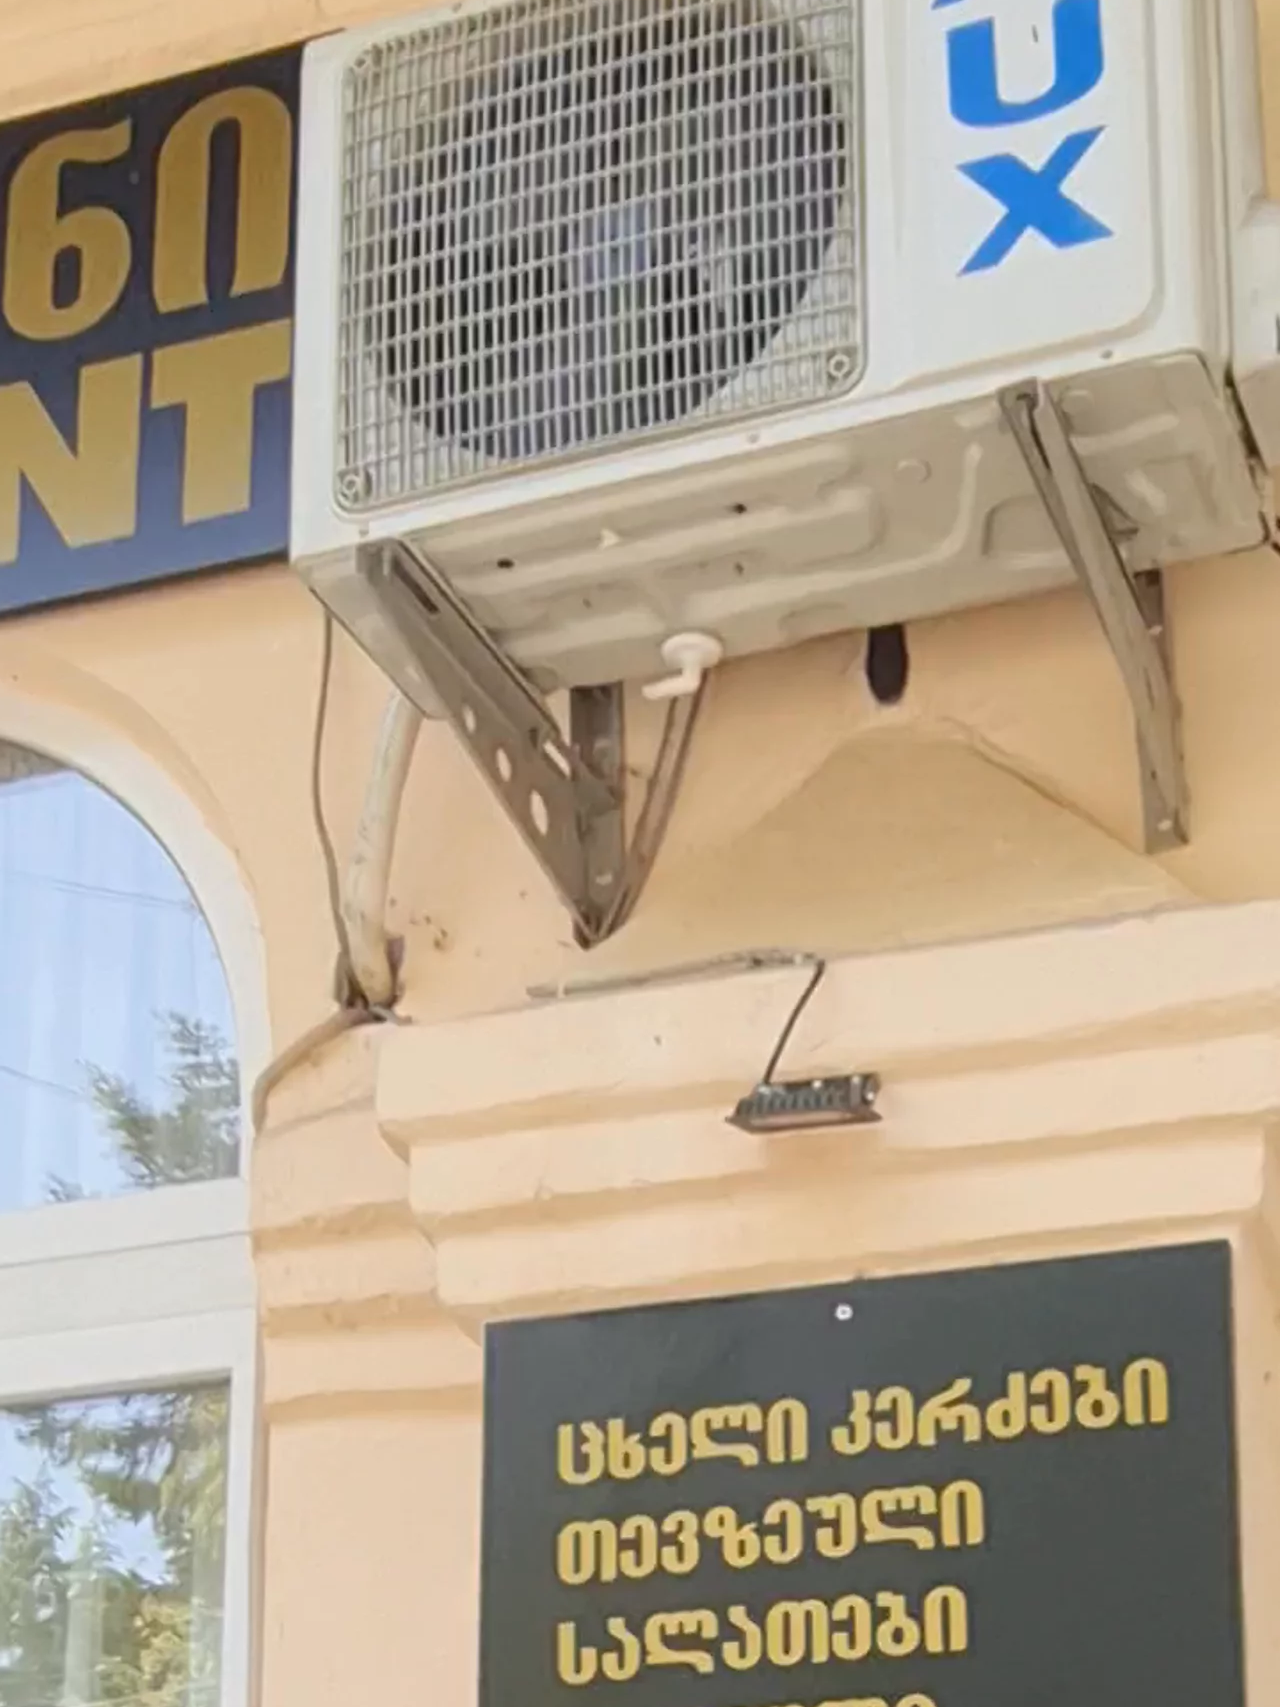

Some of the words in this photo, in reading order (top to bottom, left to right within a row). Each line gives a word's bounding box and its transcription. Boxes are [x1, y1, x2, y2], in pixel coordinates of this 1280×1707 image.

[556, 1397, 808, 1486] ცხელი
[830, 1357, 1170, 1456] კერძები
[556, 1479, 986, 1586] თევზეული
[556, 1585, 968, 1686] სალათები
